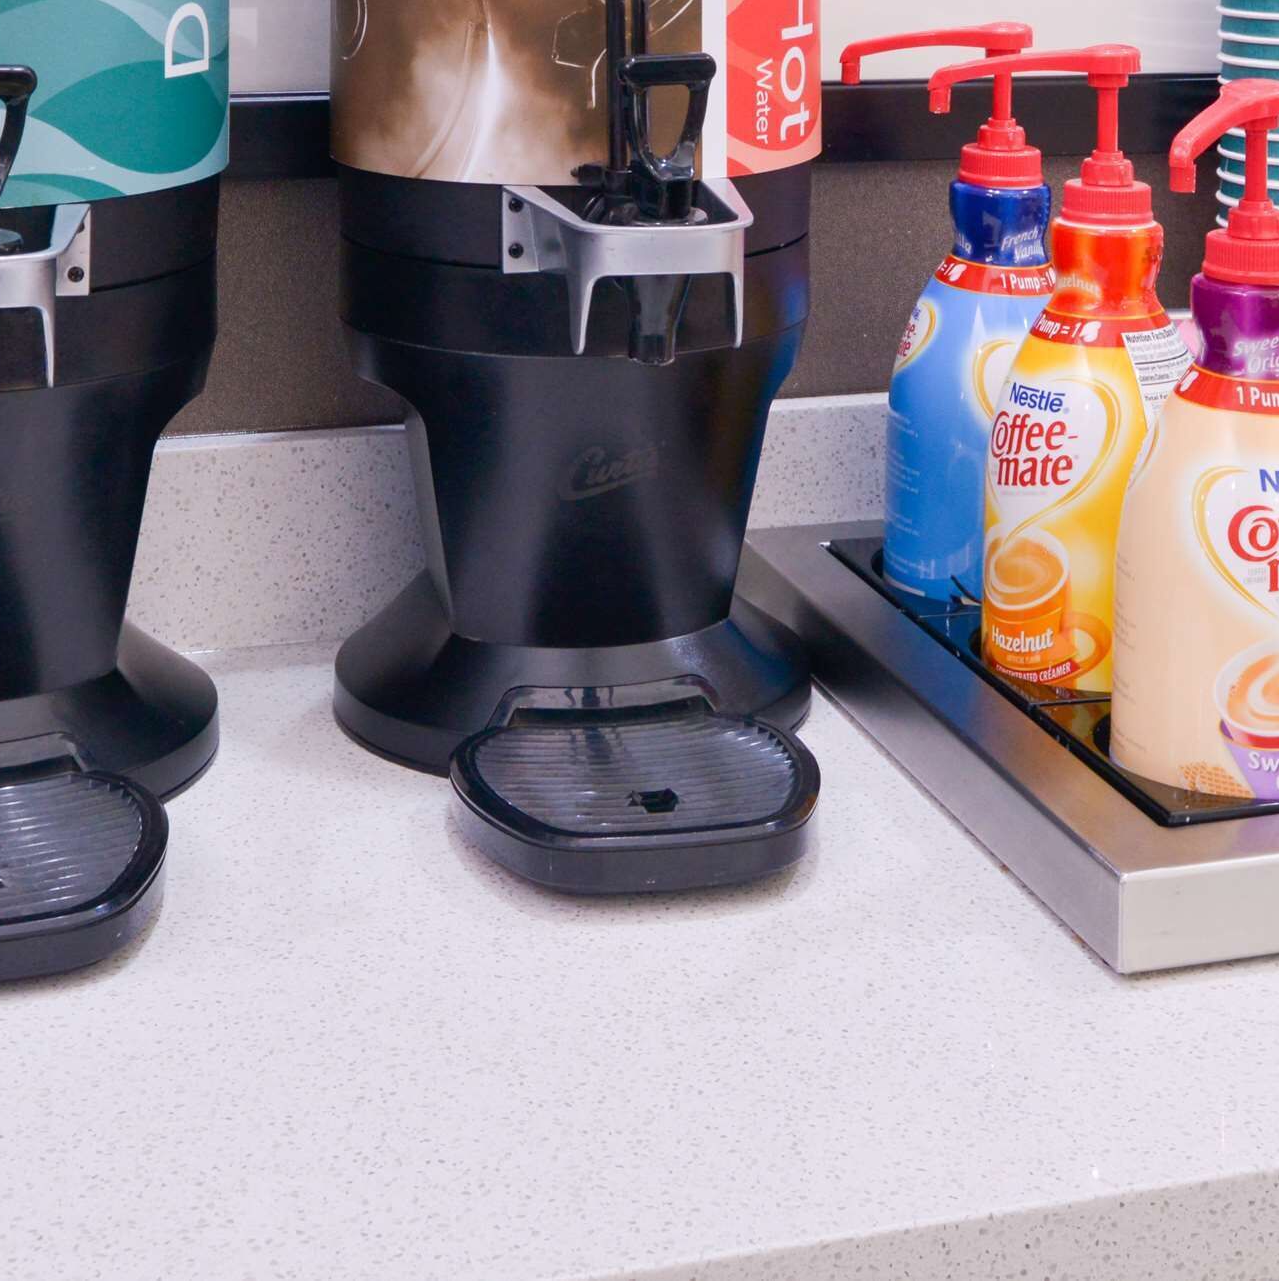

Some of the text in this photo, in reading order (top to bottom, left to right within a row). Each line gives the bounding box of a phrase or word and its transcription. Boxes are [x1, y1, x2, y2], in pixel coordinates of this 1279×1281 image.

[755, 57, 775, 145] Water
[1001, 225, 1039, 251] French
[1000, 273, 1007, 289] 1
[1009, 382, 1066, 413] Nestlé
[1236, 385, 1244, 405] 1
[996, 454, 1074, 487] mate
[991, 624, 1054, 653] Hazelnut
